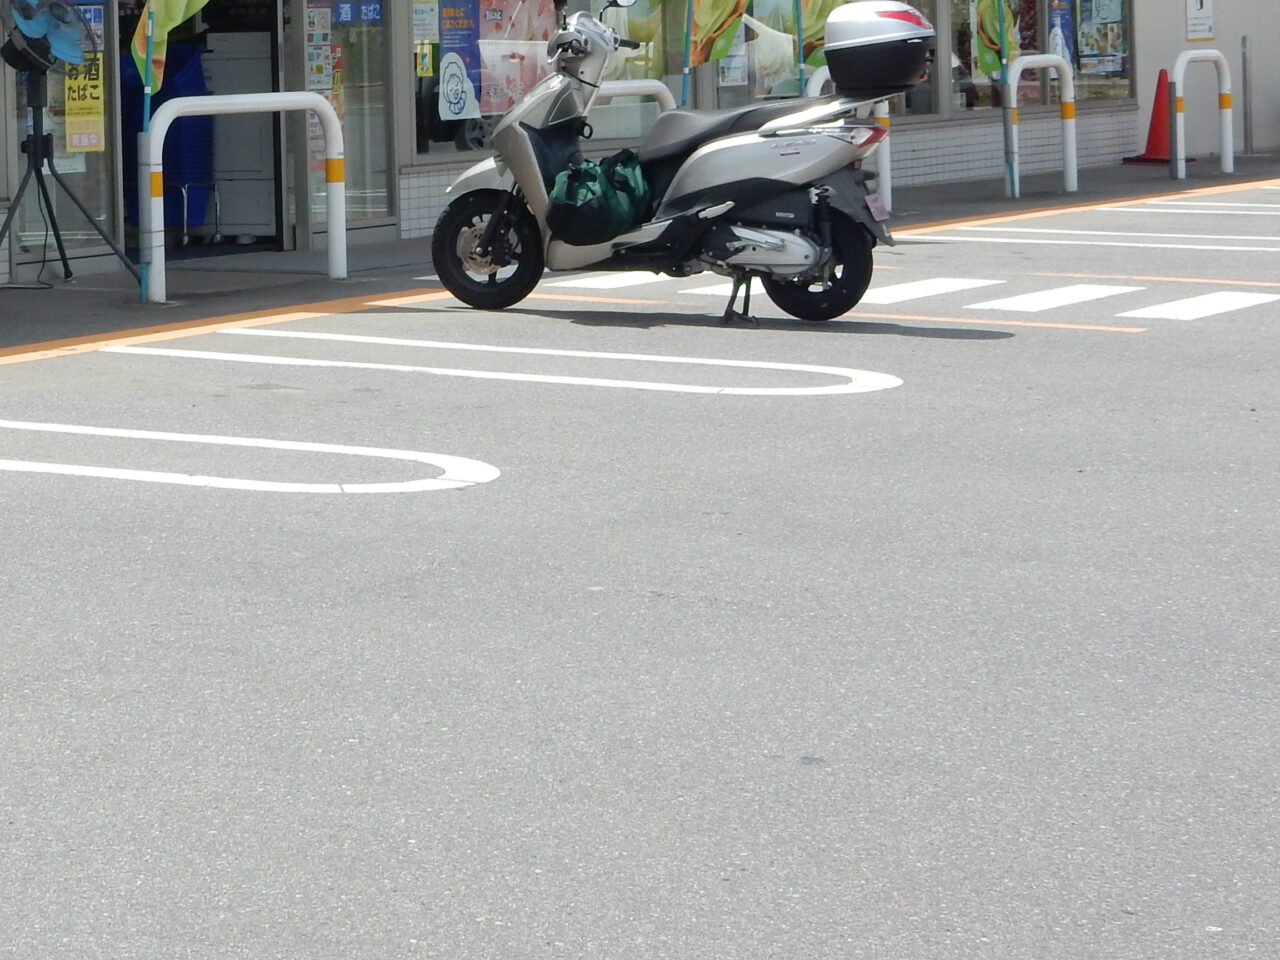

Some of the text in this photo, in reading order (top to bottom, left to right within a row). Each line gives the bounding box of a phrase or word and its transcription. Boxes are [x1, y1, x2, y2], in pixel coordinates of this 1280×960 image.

[339, 3, 351, 21] 酒
[360, 3, 382, 20] たばこ
[67, 84, 100, 101] たばこ
